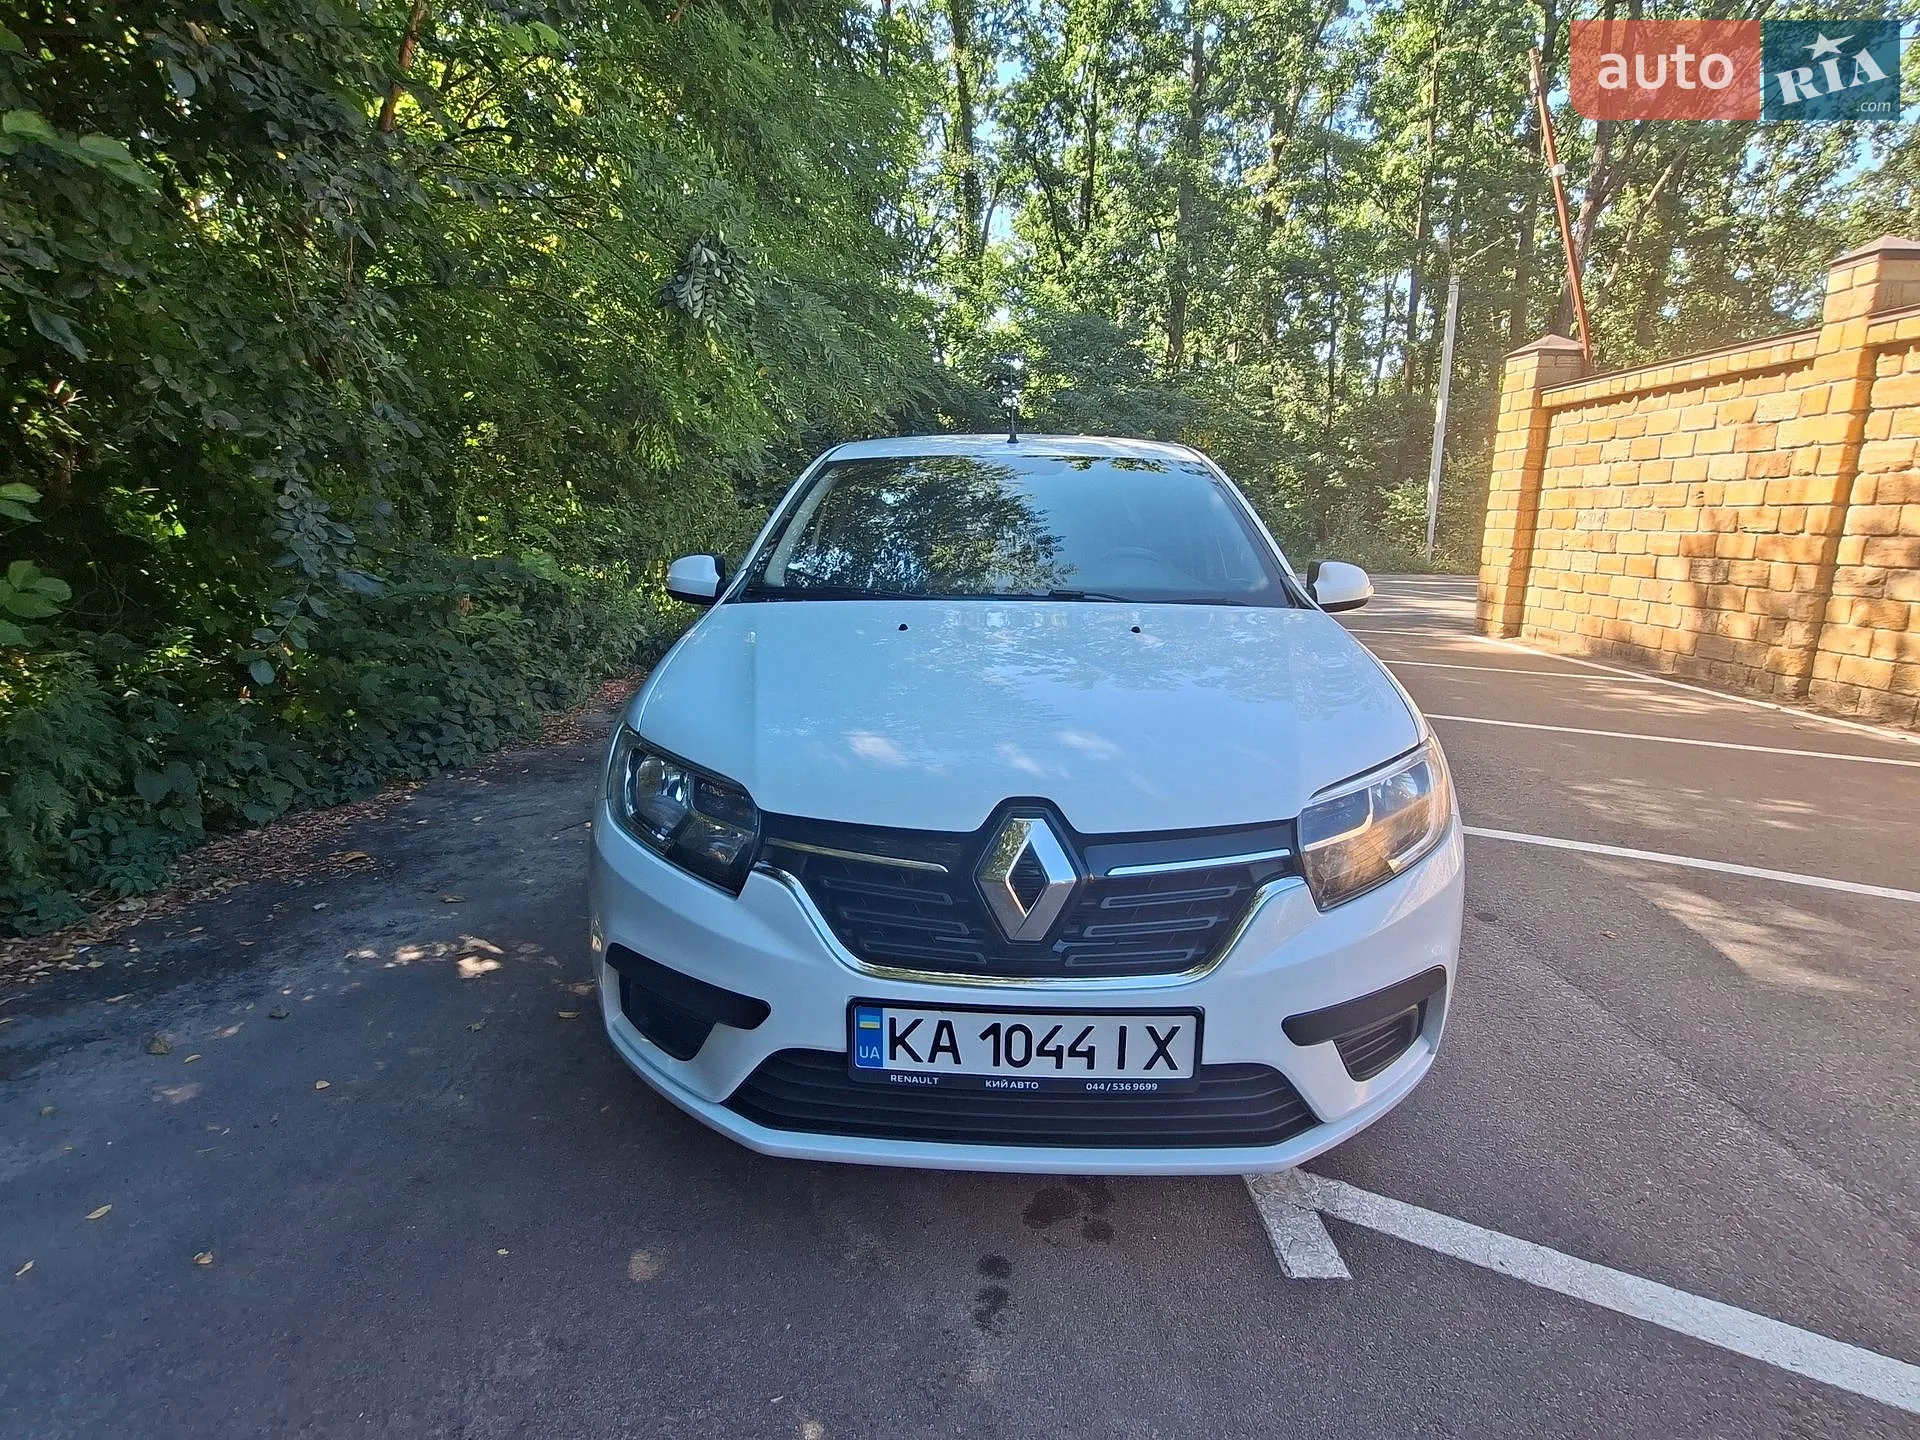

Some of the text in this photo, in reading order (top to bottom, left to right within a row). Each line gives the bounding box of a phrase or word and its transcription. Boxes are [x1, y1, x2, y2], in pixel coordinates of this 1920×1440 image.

[889, 1017, 1182, 1071] KA 1044 IX
[859, 1045, 881, 1060] UA
[890, 1074, 939, 1085] RENAULT
[985, 1079, 1039, 1090] КИЙ АВТО
